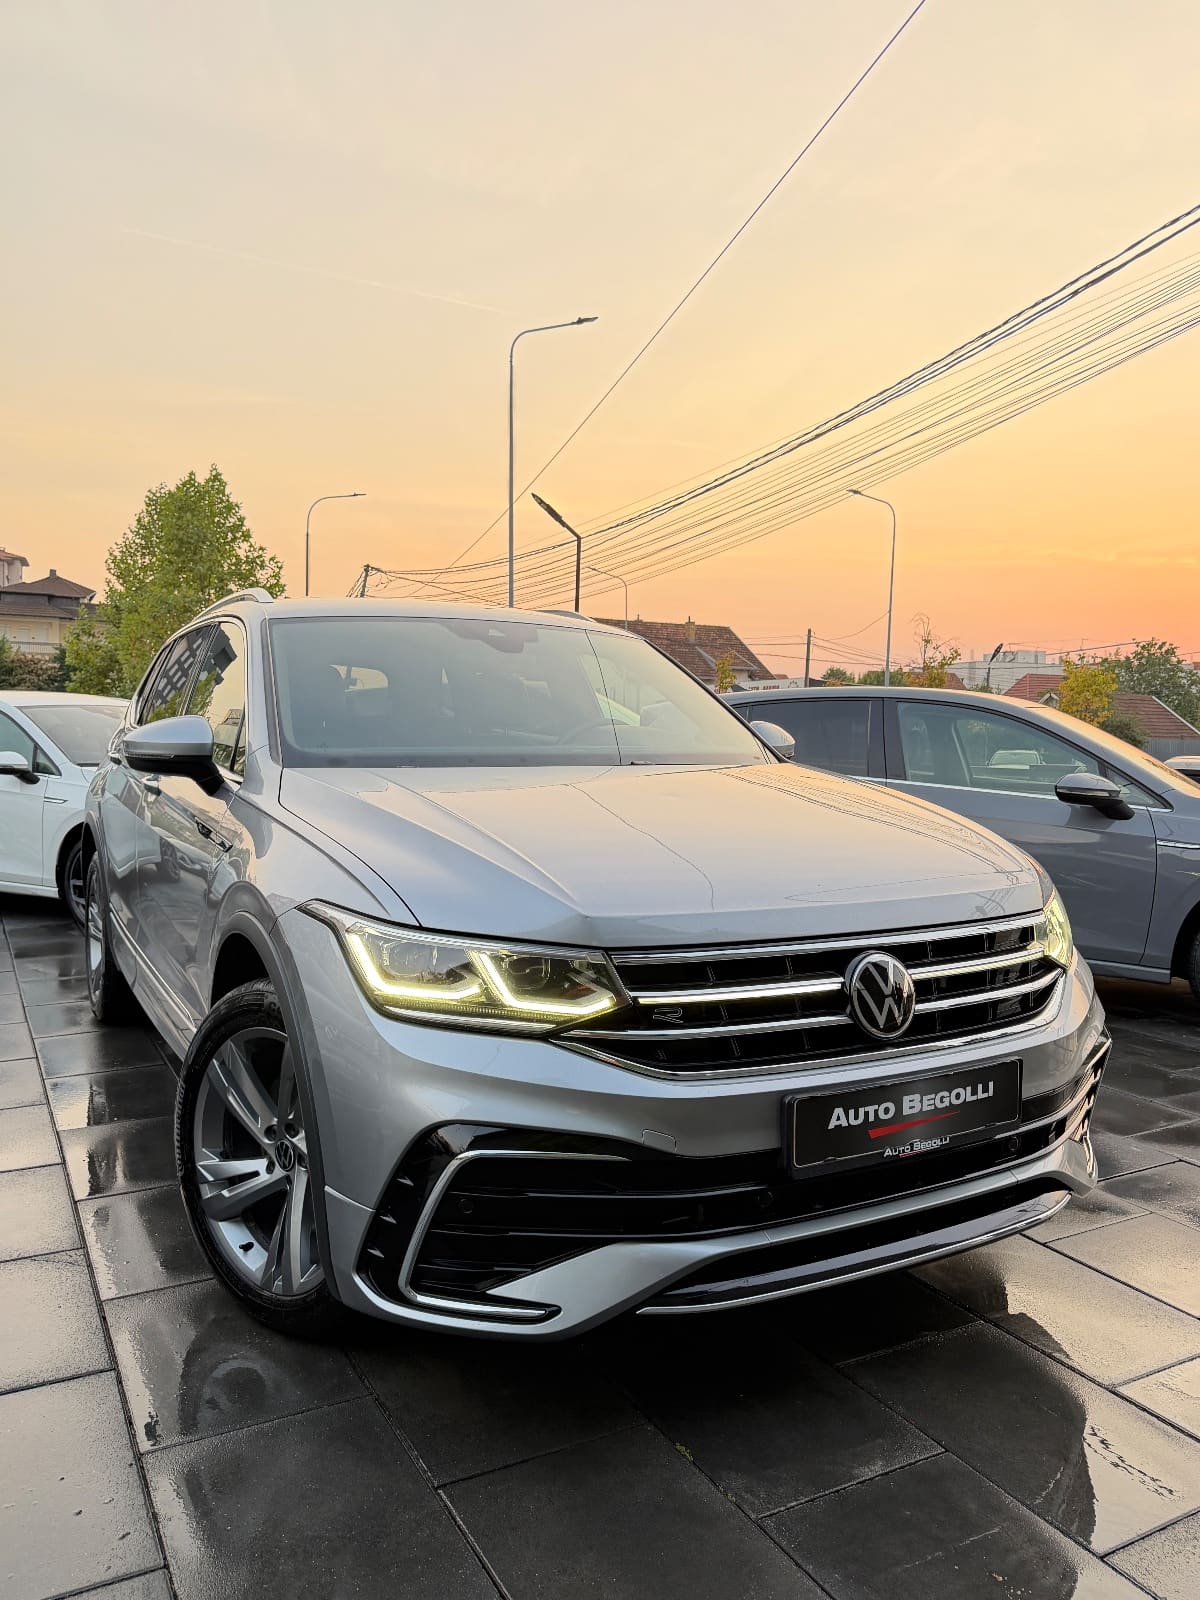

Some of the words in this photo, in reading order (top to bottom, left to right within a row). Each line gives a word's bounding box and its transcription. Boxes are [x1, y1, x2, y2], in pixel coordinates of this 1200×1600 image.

[827, 1101, 896, 1130] AUTO
[902, 1080, 994, 1116] BEGOLLI
[883, 1144, 911, 1158] AUTO
[913, 1136, 950, 1151] BEGOLLI
